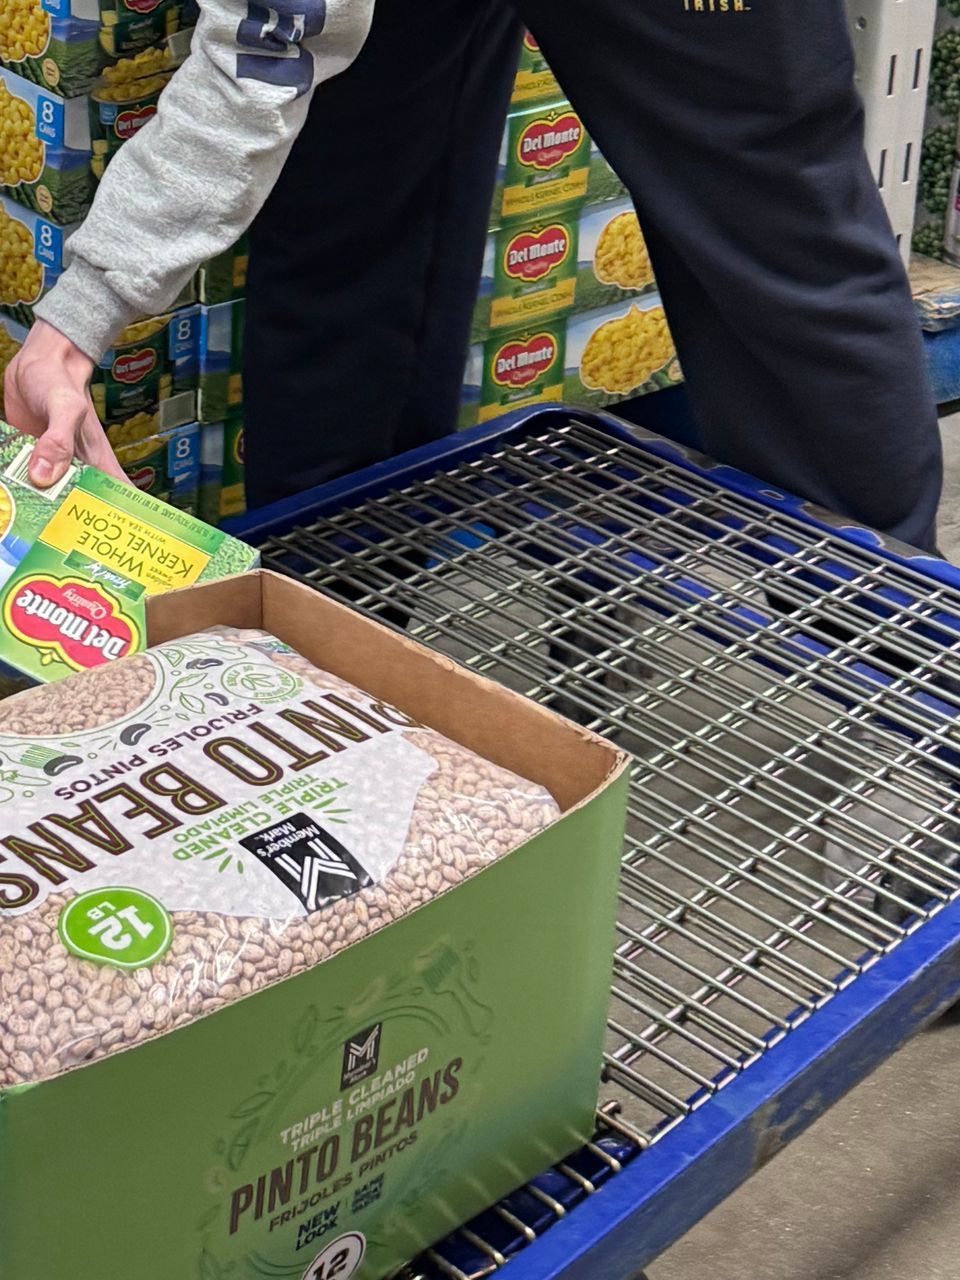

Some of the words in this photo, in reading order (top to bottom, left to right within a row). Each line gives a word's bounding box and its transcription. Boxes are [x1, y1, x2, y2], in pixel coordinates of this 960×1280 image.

[42, 100, 55, 123] 8
[40, 225, 53, 248] 8
[66, 503, 124, 538] CORN
[76, 529, 147, 578] WHOLE
[127, 530, 195, 579] KERNEL
[15, 588, 91, 639] Monte
[61, 587, 108, 620] Quality
[84, 625, 128, 661] Del
[154, 702, 264, 759] FRIJOLES
[53, 753, 151, 800] PINTOS
[260, 773, 320, 805] TRIPLE
[275, 776, 348, 815] TRIPLE
[171, 810, 272, 861] CLEANED
[172, 800, 259, 844] LIMPIADO
[255, 824, 320, 858] Member's
[87, 900, 117, 921] LB
[87, 906, 154, 950] 12
[279, 1098, 343, 1144] TRIPLE
[348, 1047, 430, 1106] CLEANED
[290, 1116, 343, 1152] TRIPLE
[346, 1071, 417, 1121] LIMPIADO
[228, 1134, 340, 1236] PINTO
[349, 1056, 463, 1165] BEANS
[268, 1171, 354, 1233] FRIJOLES
[358, 1130, 418, 1178] PINTOS
[295, 1217, 340, 1252] LOOK
[296, 1201, 342, 1237] NEW
